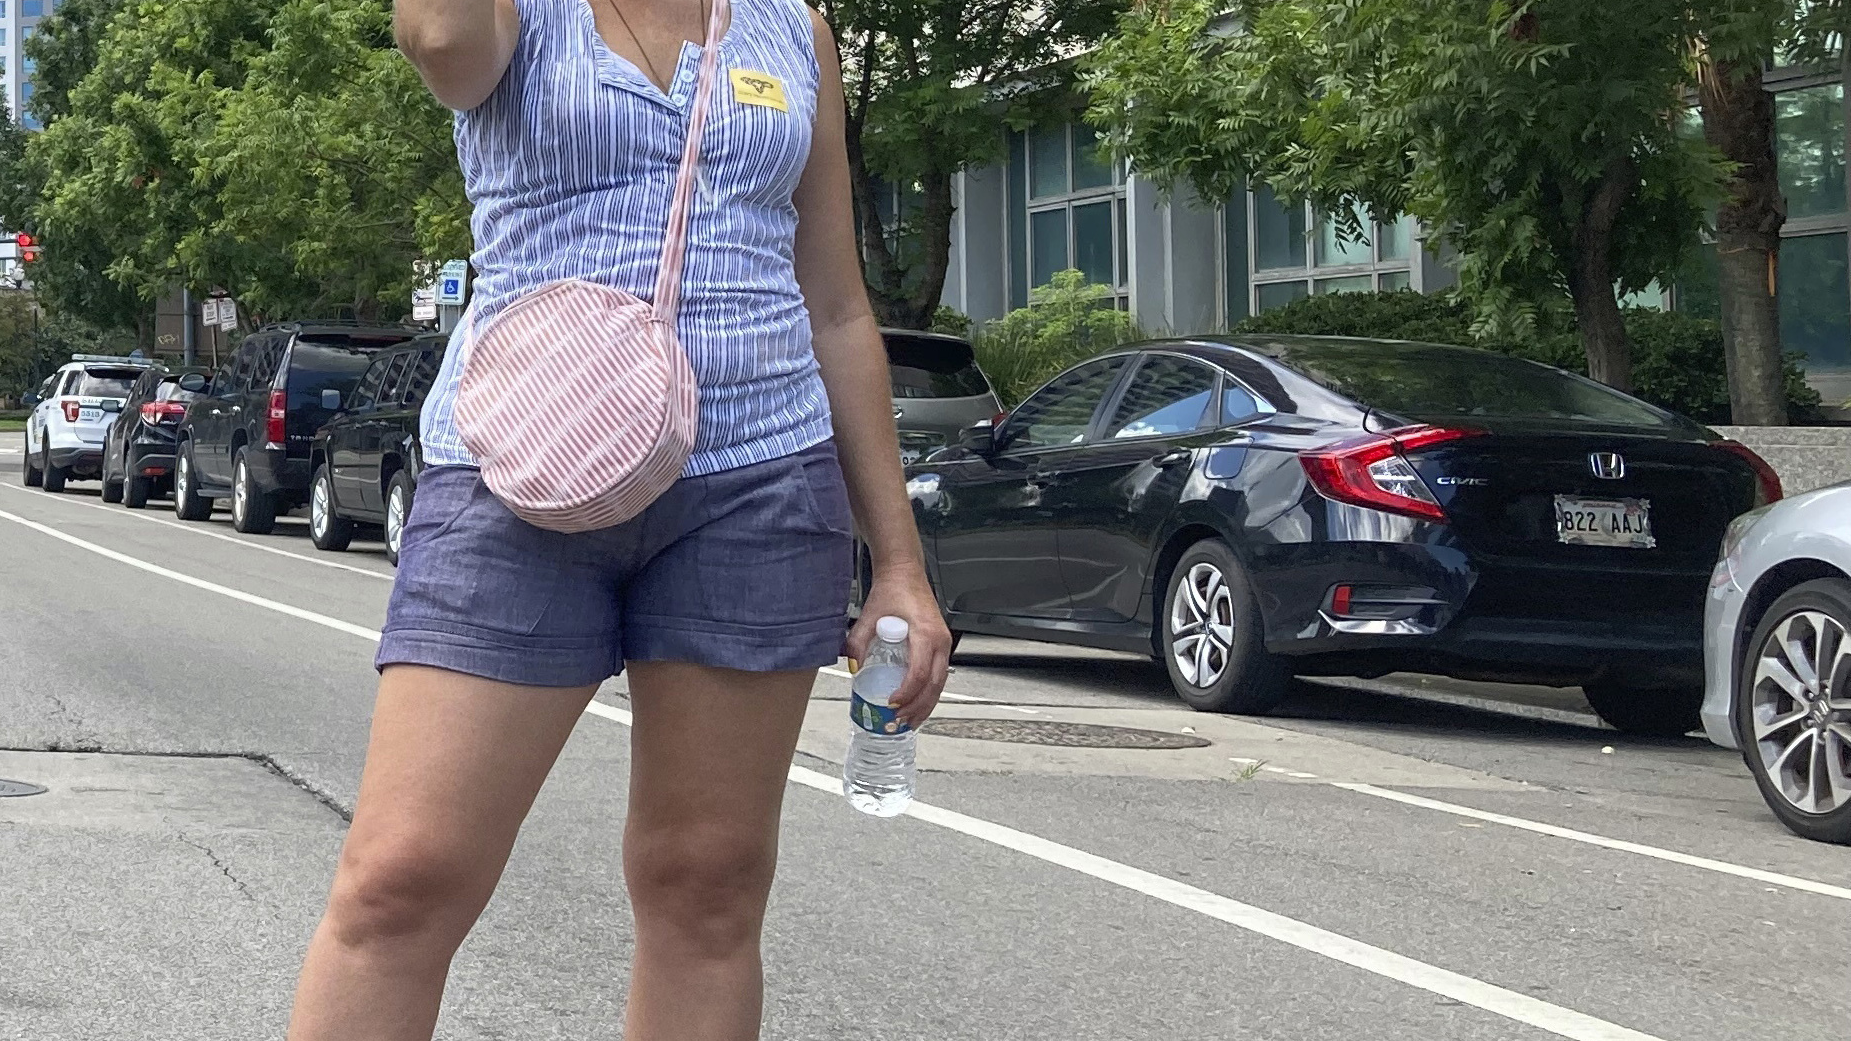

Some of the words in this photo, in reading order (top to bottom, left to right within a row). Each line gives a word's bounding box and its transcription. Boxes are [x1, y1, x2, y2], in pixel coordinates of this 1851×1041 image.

[1437, 476, 1488, 485] CIVIC
[1564, 511, 1598, 531] 822
[1611, 512, 1643, 533] AAJ
